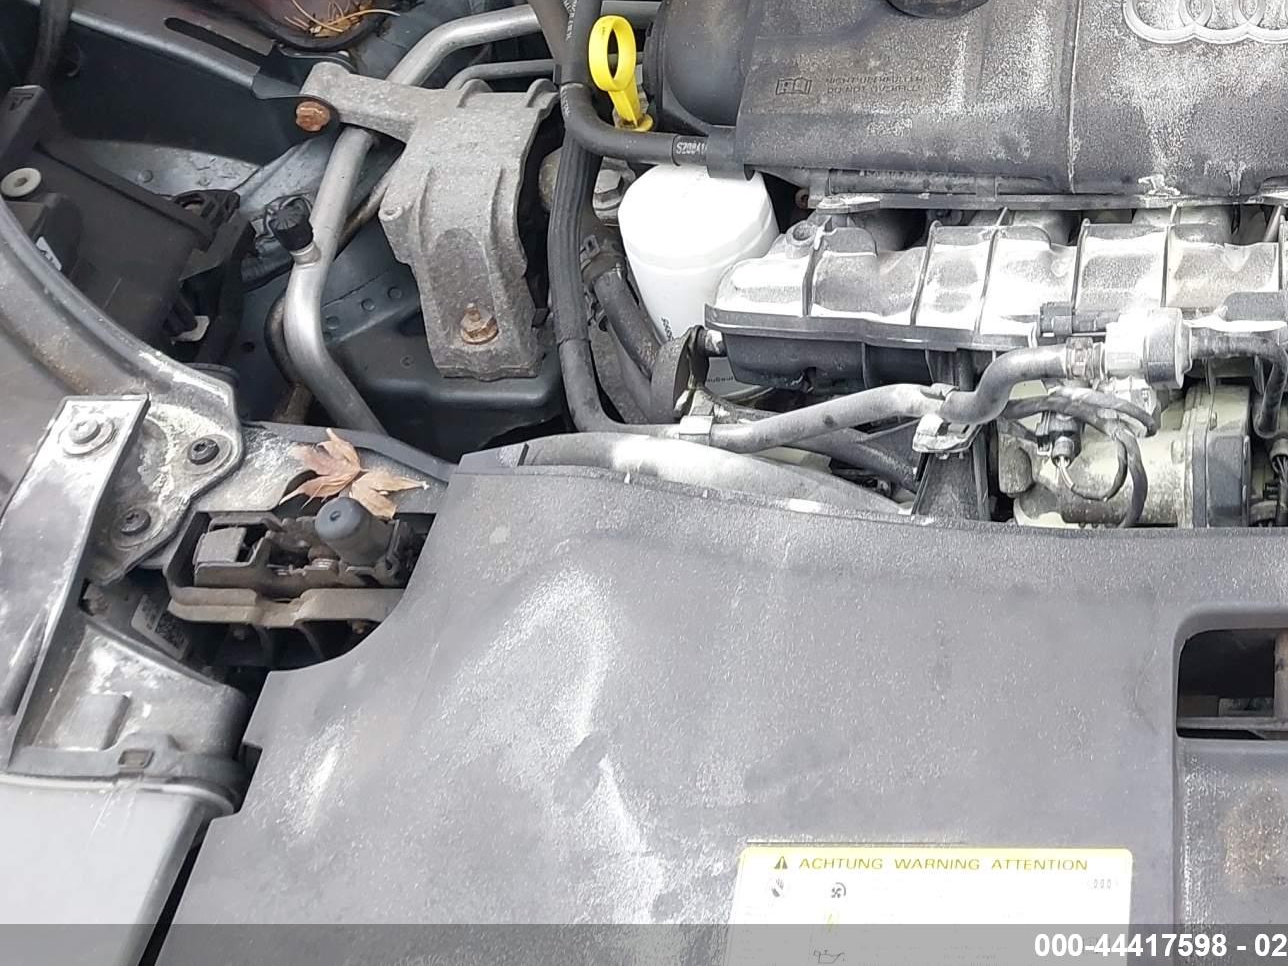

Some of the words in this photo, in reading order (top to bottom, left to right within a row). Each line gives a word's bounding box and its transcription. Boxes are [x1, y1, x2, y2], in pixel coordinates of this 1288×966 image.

[799, 858, 883, 870] ACHTUNG
[894, 858, 980, 871] WARNING
[992, 859, 1088, 871] ATTENTION
